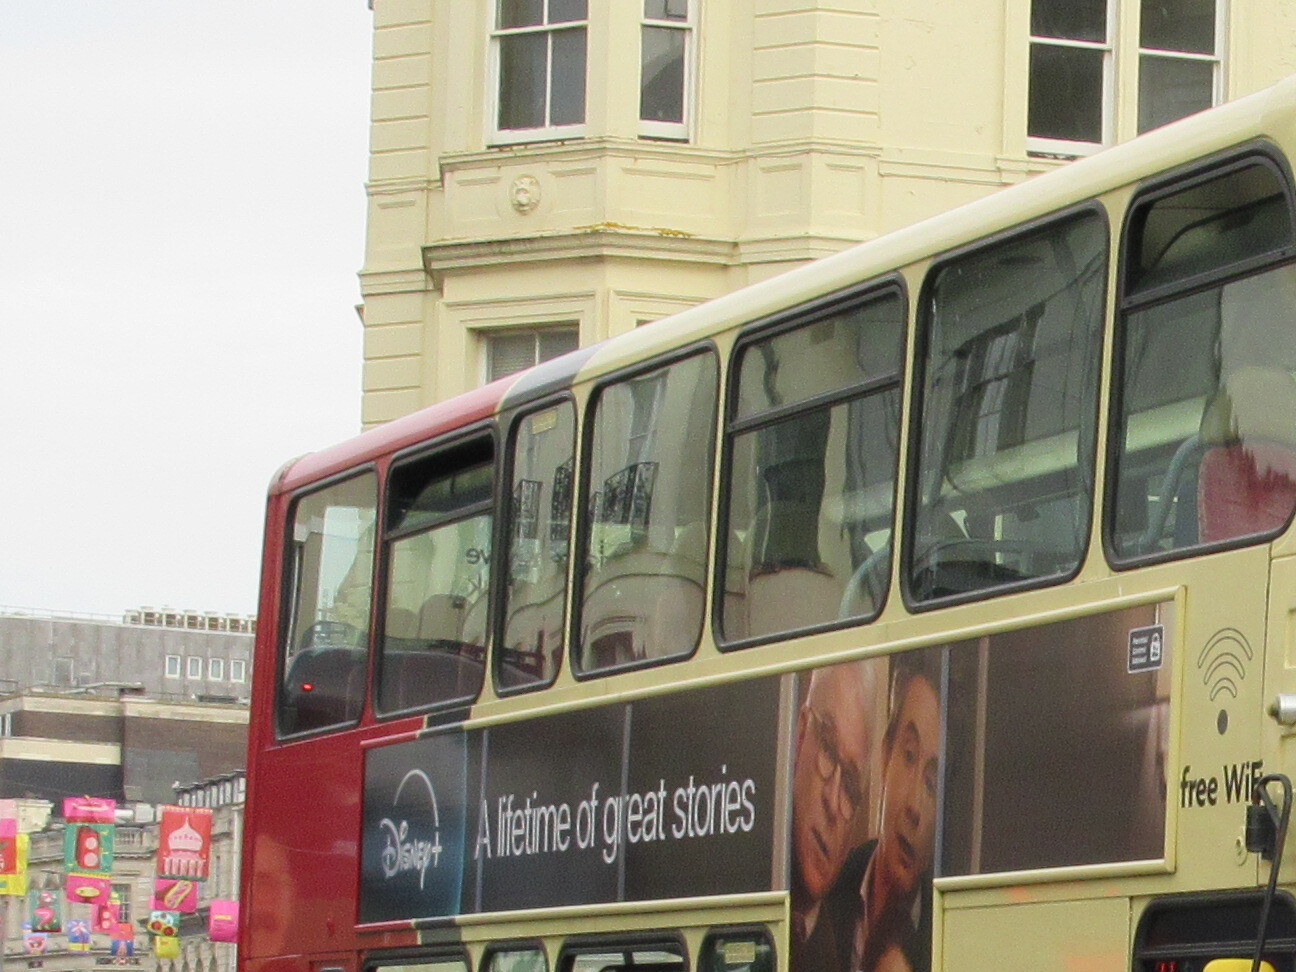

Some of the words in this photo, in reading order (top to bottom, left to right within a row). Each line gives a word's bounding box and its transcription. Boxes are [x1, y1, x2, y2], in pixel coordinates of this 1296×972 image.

[474, 799, 491, 859] A
[496, 790, 571, 858] lifetime
[576, 781, 599, 850] of
[602, 779, 668, 865] great
[672, 764, 756, 840] stories
[1180, 765, 1219, 808] free
